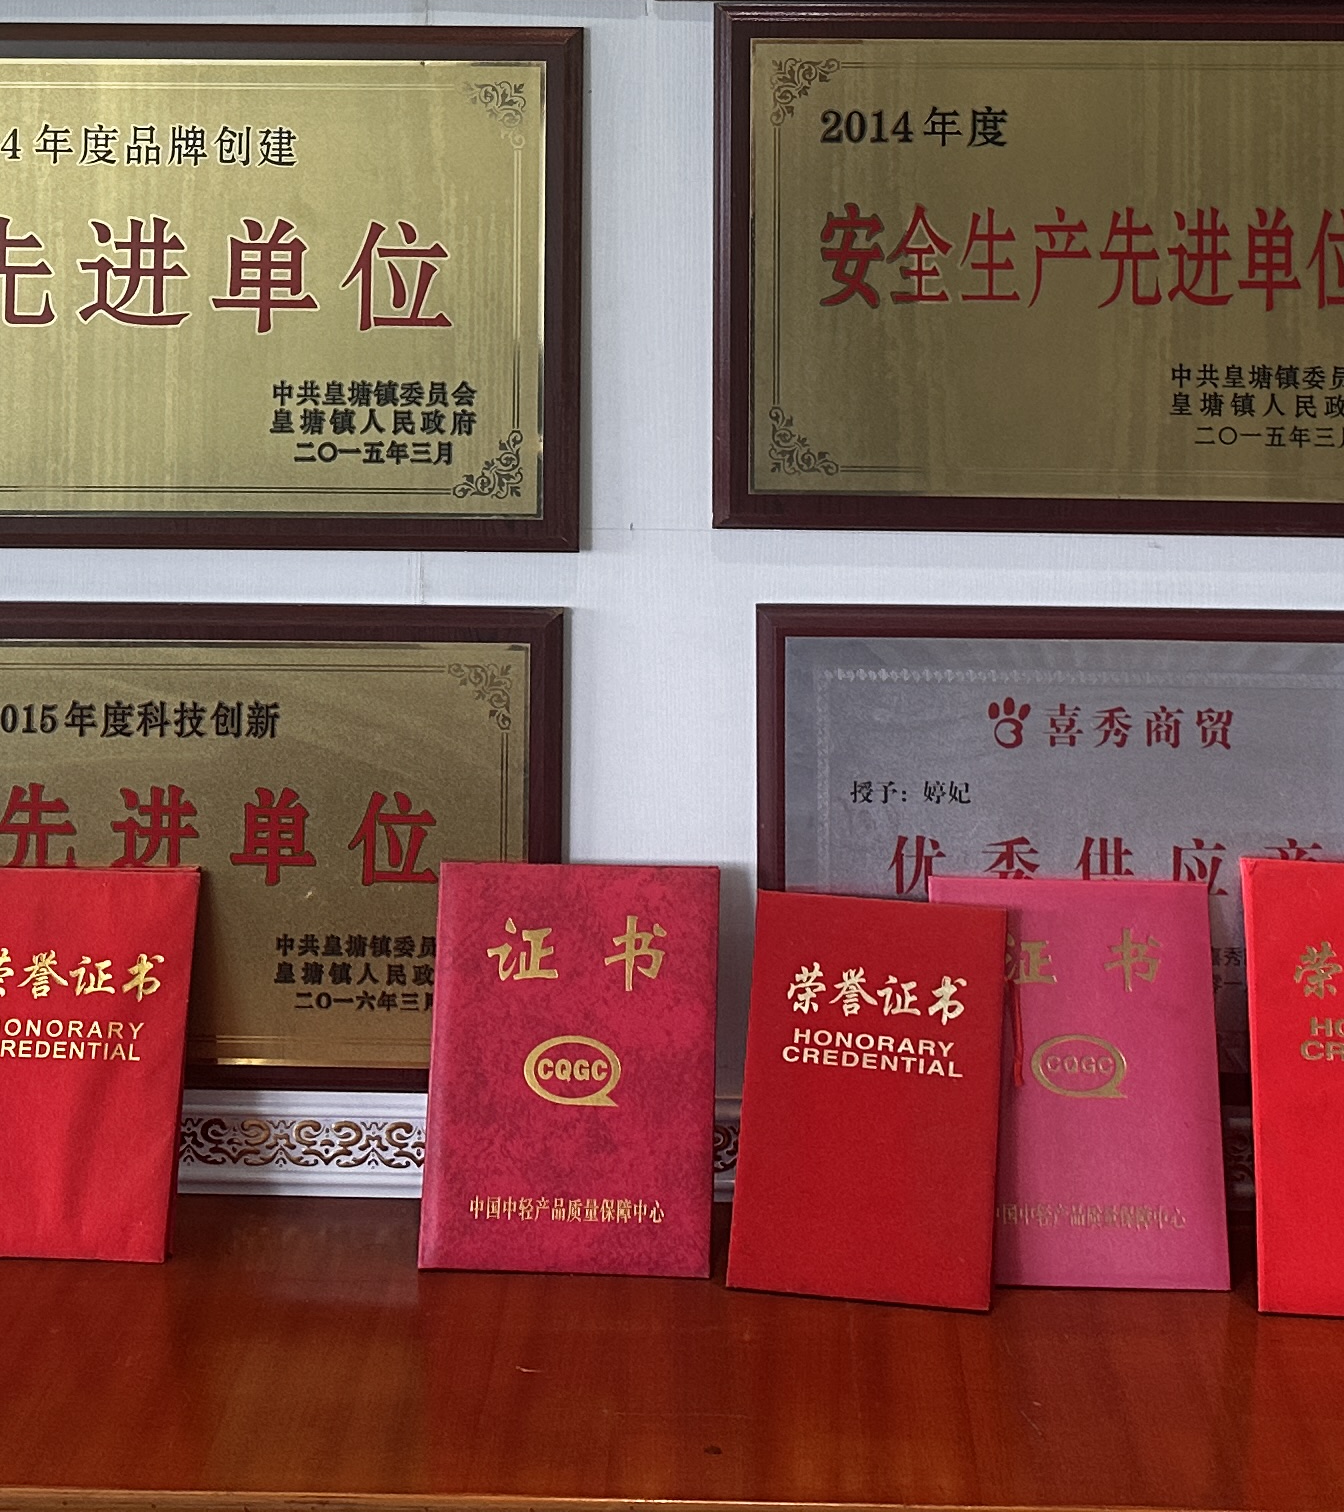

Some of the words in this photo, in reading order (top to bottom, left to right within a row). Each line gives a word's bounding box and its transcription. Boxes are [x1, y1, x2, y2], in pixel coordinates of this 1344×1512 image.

[271, 380, 477, 407] 中共皇塘镇委员会
[270, 408, 478, 437] 皇塘镇人民政府
[1042, 704, 1234, 751] 喜秀商贸
[484, 913, 668, 994] 证书
[1006, 927, 1163, 993] 证书
[784, 962, 969, 1028] 荣誉证书
[791, 1026, 957, 1059] HONORARY
[536, 1056, 610, 1083] CQGC
[780, 1043, 965, 1080] CREDENTIAL
[1045, 1053, 1117, 1080] CQGC
[468, 1194, 667, 1227] 中国中轻产品质量保障中心
